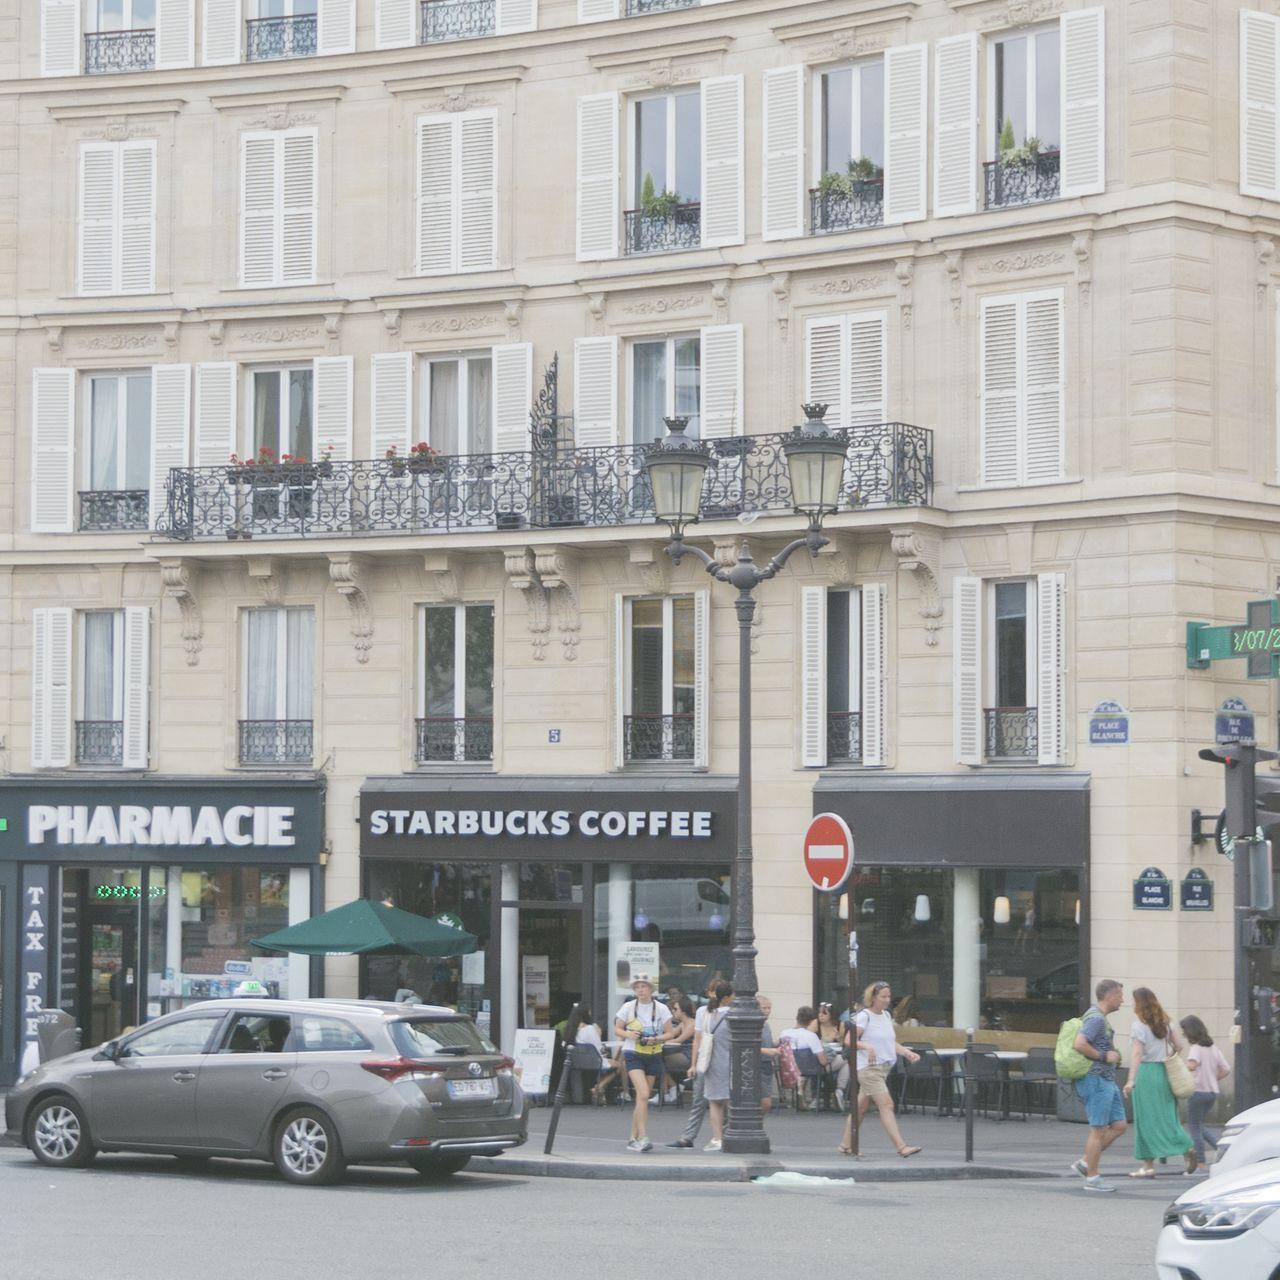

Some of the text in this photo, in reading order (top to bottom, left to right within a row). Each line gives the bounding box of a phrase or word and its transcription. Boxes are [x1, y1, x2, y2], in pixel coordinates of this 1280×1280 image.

[28, 805, 296, 847] PHARMACIE
[370, 809, 713, 837] STARBUCKS COFFEE
[25, 886, 45, 951] TAX
